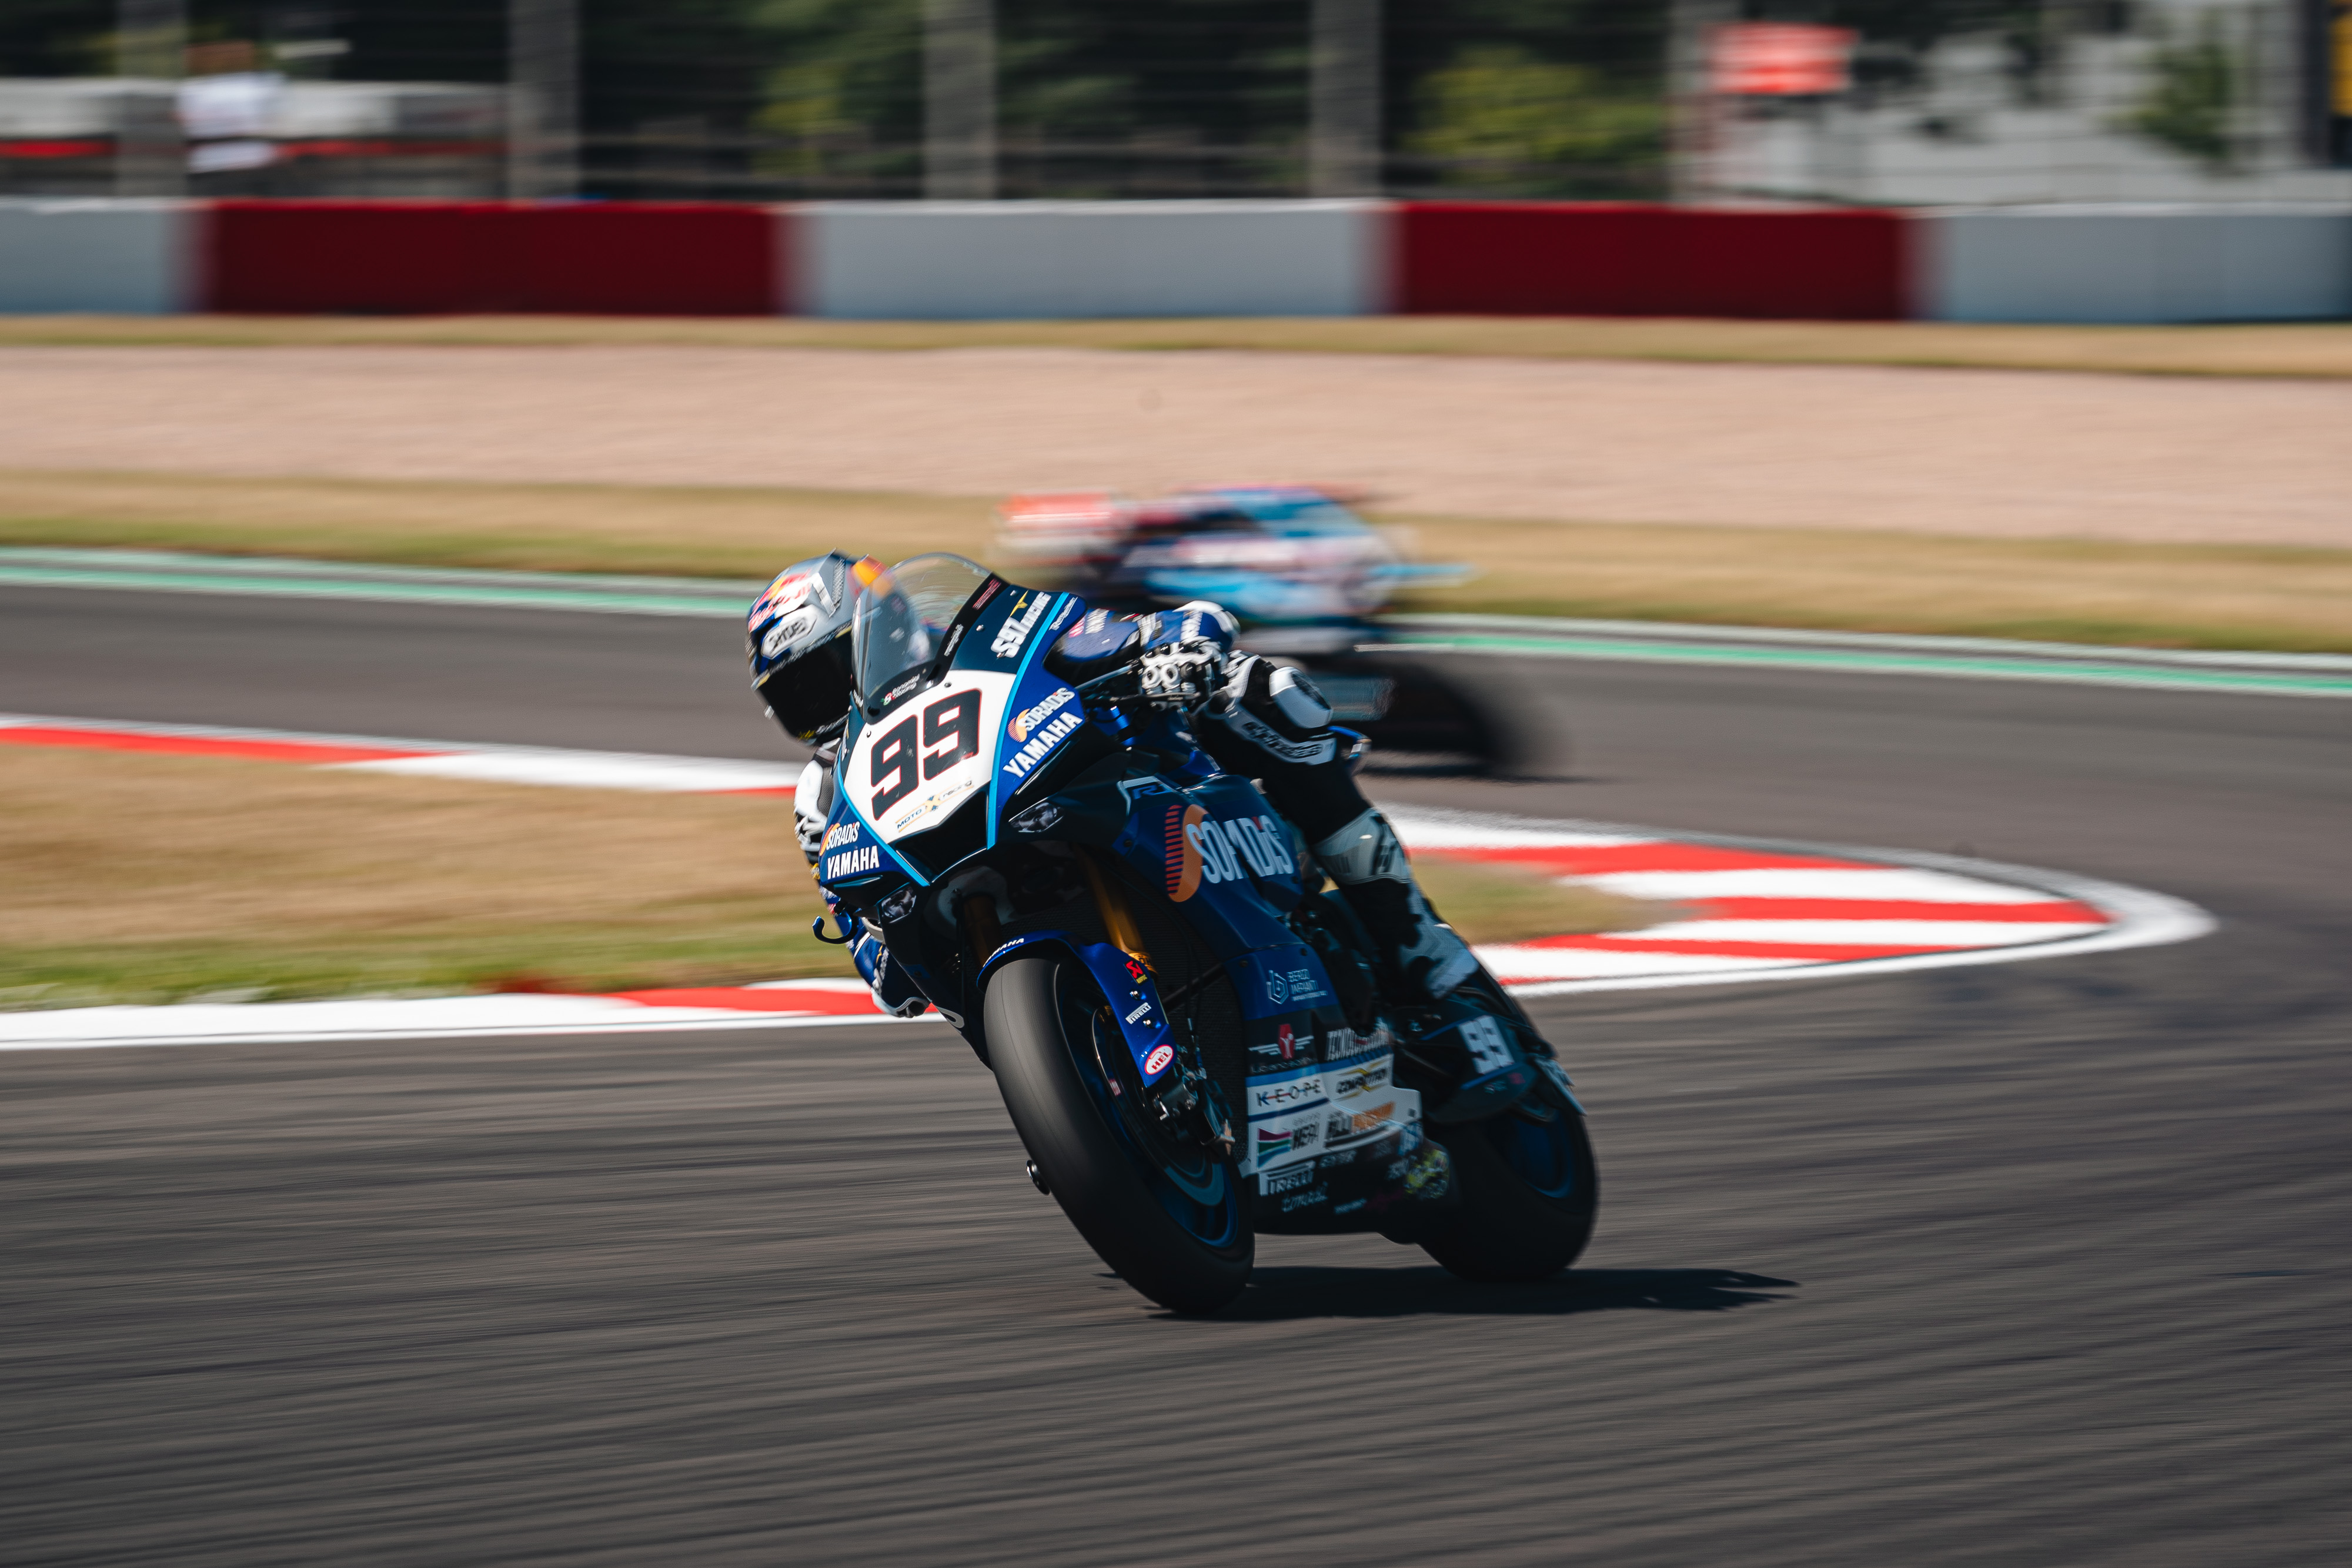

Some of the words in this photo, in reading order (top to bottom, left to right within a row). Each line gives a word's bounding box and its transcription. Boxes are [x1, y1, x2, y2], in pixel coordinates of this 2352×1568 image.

[871, 688, 982, 821] 99
[1003, 711, 1083, 778] YAMAHA
[897, 808, 922, 829] MOTO
[827, 845, 880, 880] YAMAHA
[983, 938, 1024, 968] MAHA
[1125, 1002, 1151, 1024] PIRELLI
[1151, 1052, 1171, 1070] HEL
[1256, 1078, 1321, 1106] KEOPE
[1258, 1160, 1317, 1196] PIRELLI
